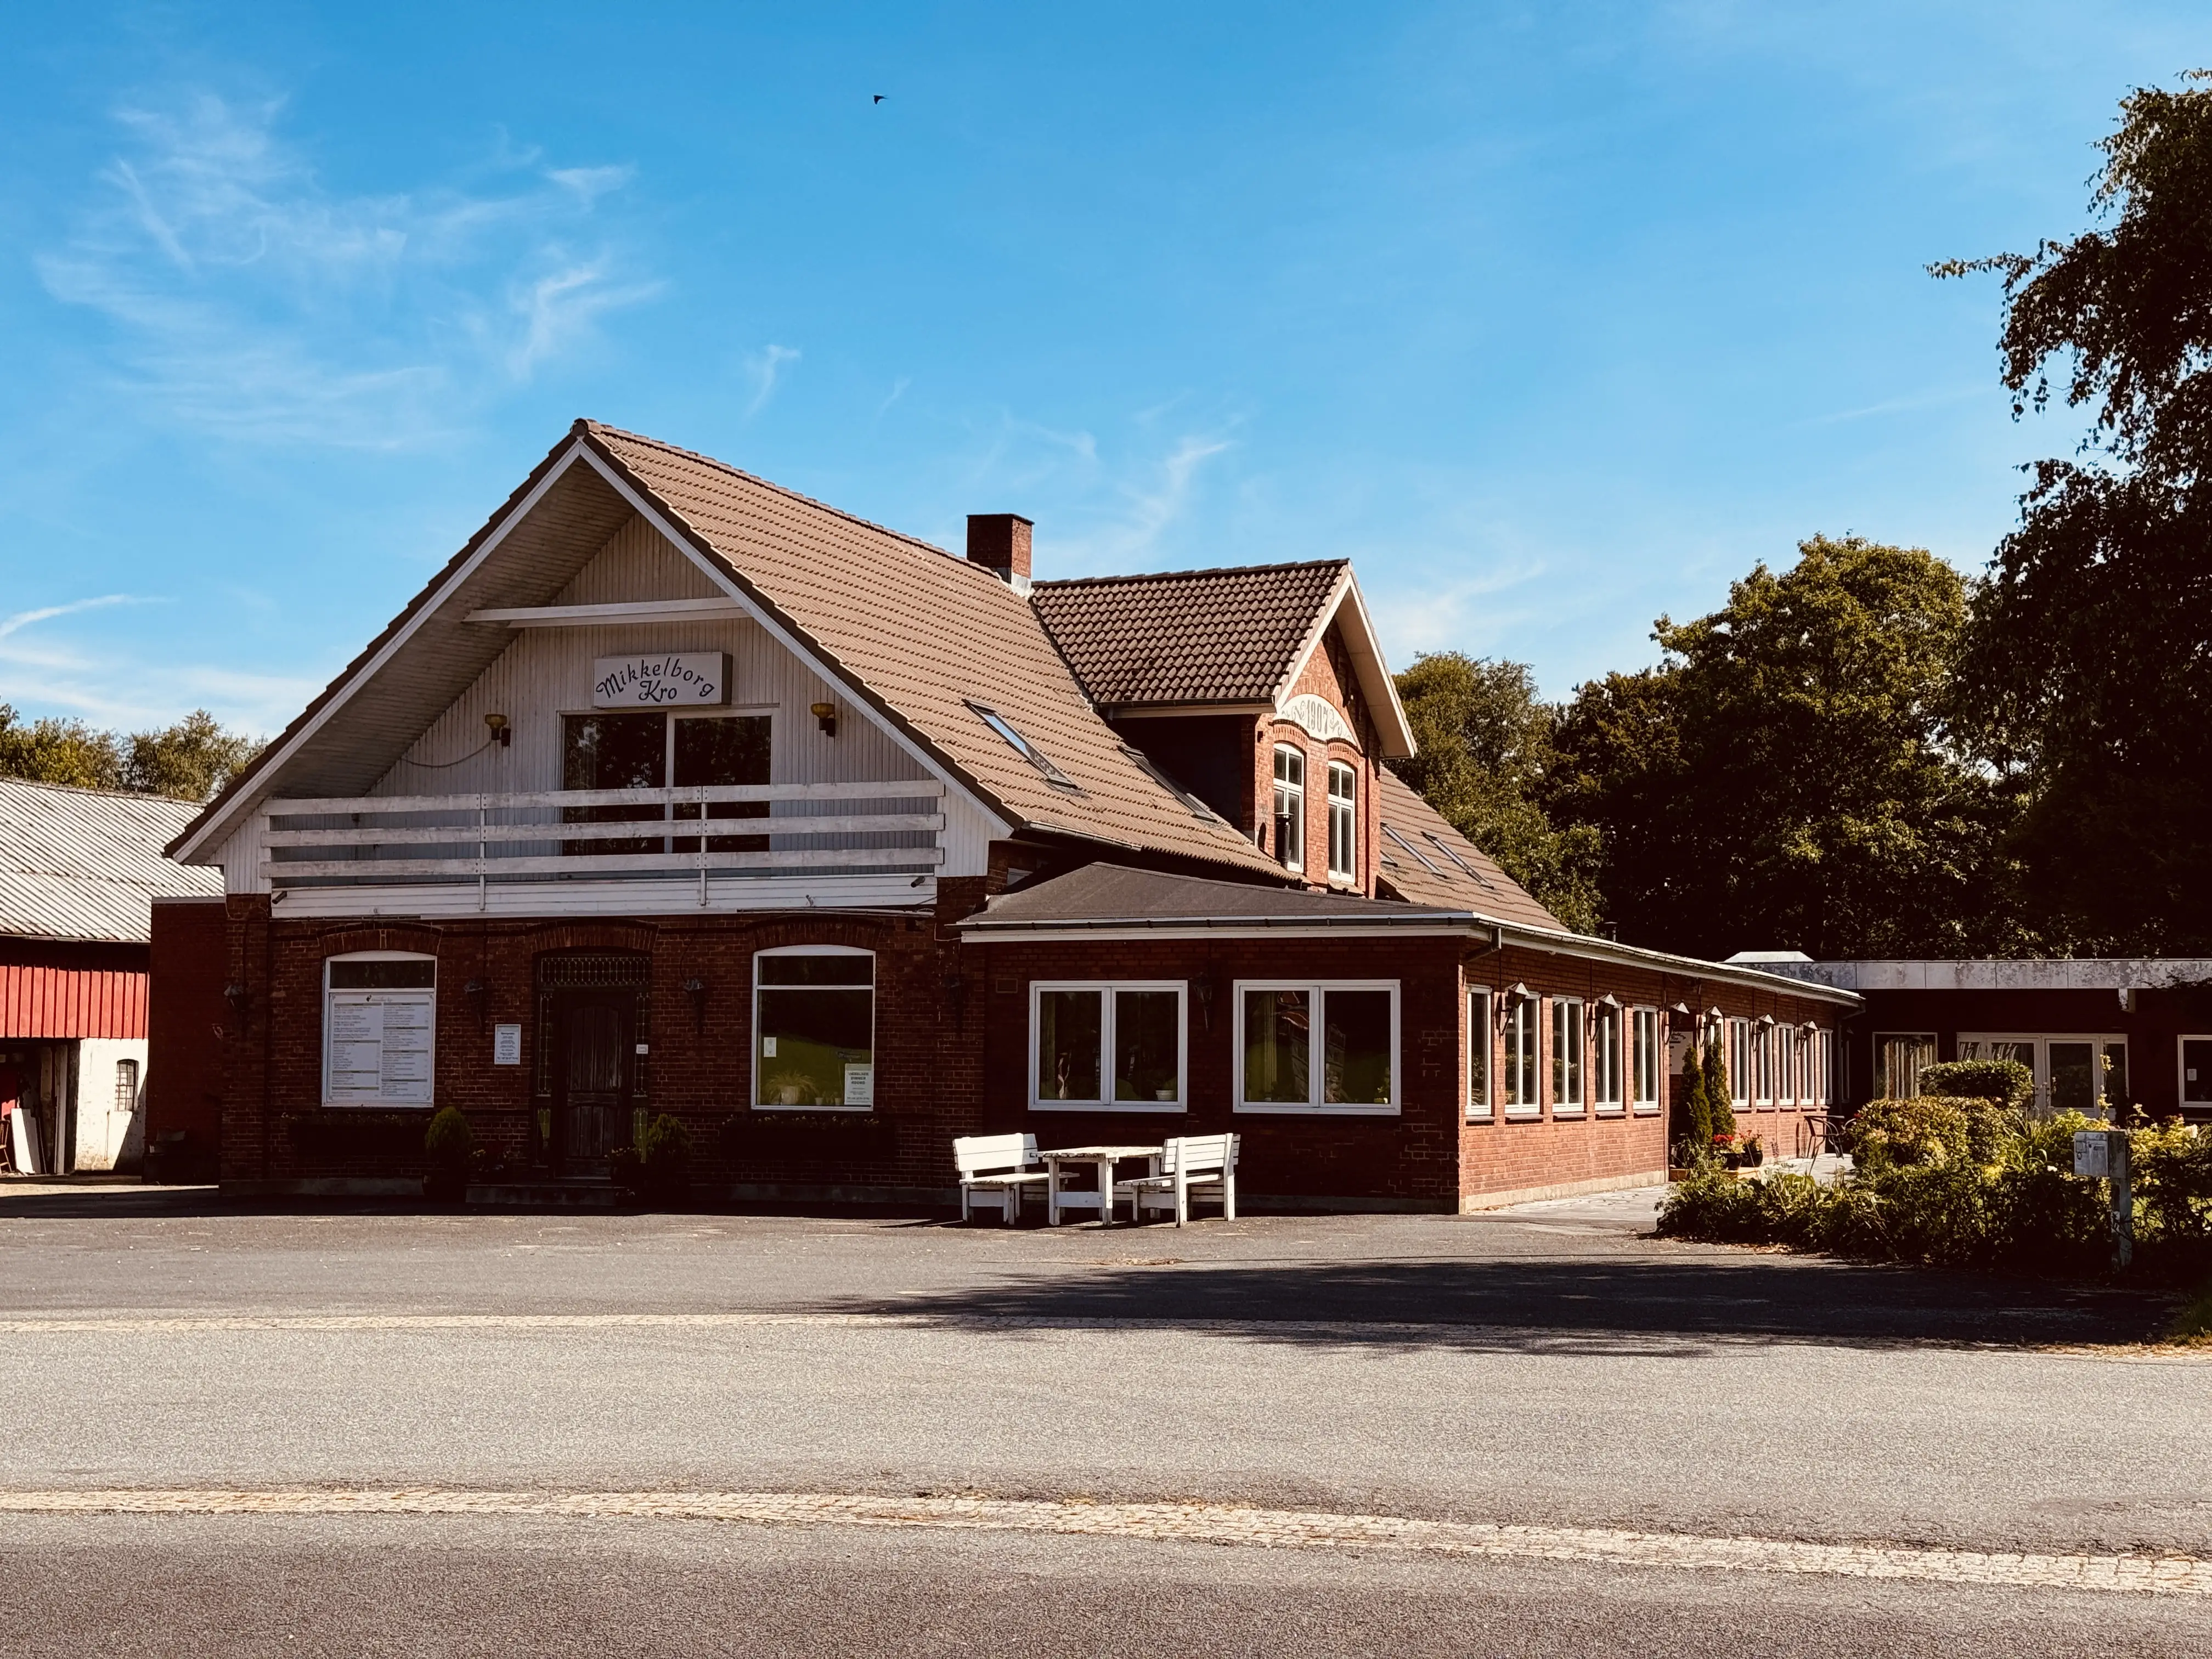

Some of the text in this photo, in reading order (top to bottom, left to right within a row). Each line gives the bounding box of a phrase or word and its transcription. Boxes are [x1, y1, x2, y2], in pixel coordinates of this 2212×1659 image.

[596, 657, 714, 698] Mikkelborg
[639, 680, 678, 702] Kro
[1307, 699, 1329, 734] 1907
